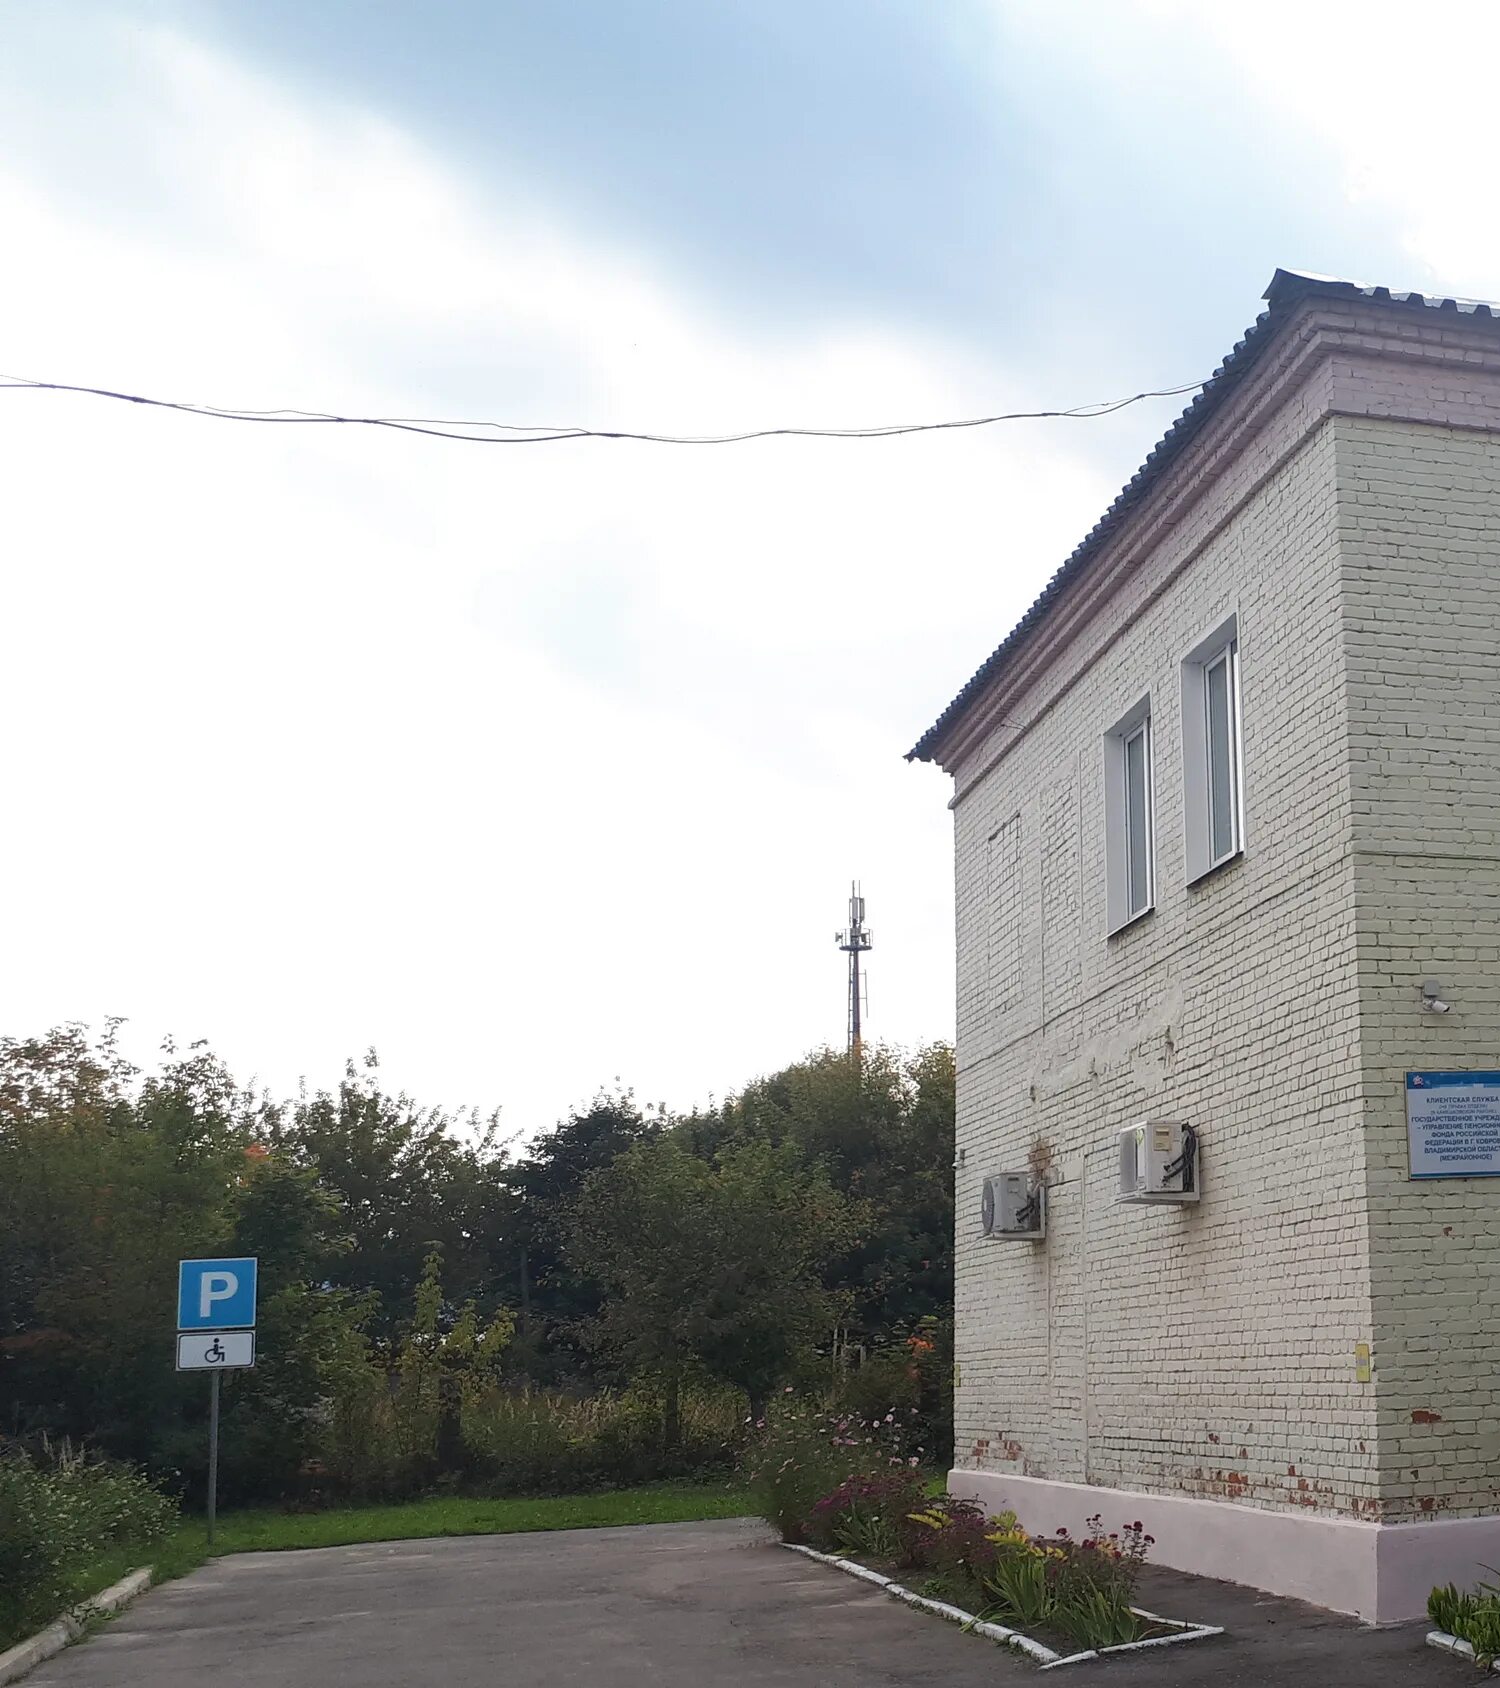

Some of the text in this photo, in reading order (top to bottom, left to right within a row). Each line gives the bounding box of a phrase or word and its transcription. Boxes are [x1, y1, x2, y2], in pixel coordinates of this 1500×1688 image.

[1472, 1095, 1500, 1103] СЛУЖБА
[1411, 1115, 1473, 1123] ГОСУДАРСТВЕННОЕ
[1455, 1129, 1498, 1137] РОССИЙСКОЙ
[1424, 1138, 1463, 1146] ФЕДЕРАЦИИ
[1424, 1146, 1477, 1154] ВЛАДИМИРСКОЙ
[1439, 1154, 1493, 1162] (МЕЖРАЙОННОЕ)
[200, 1271, 238, 1317] P
